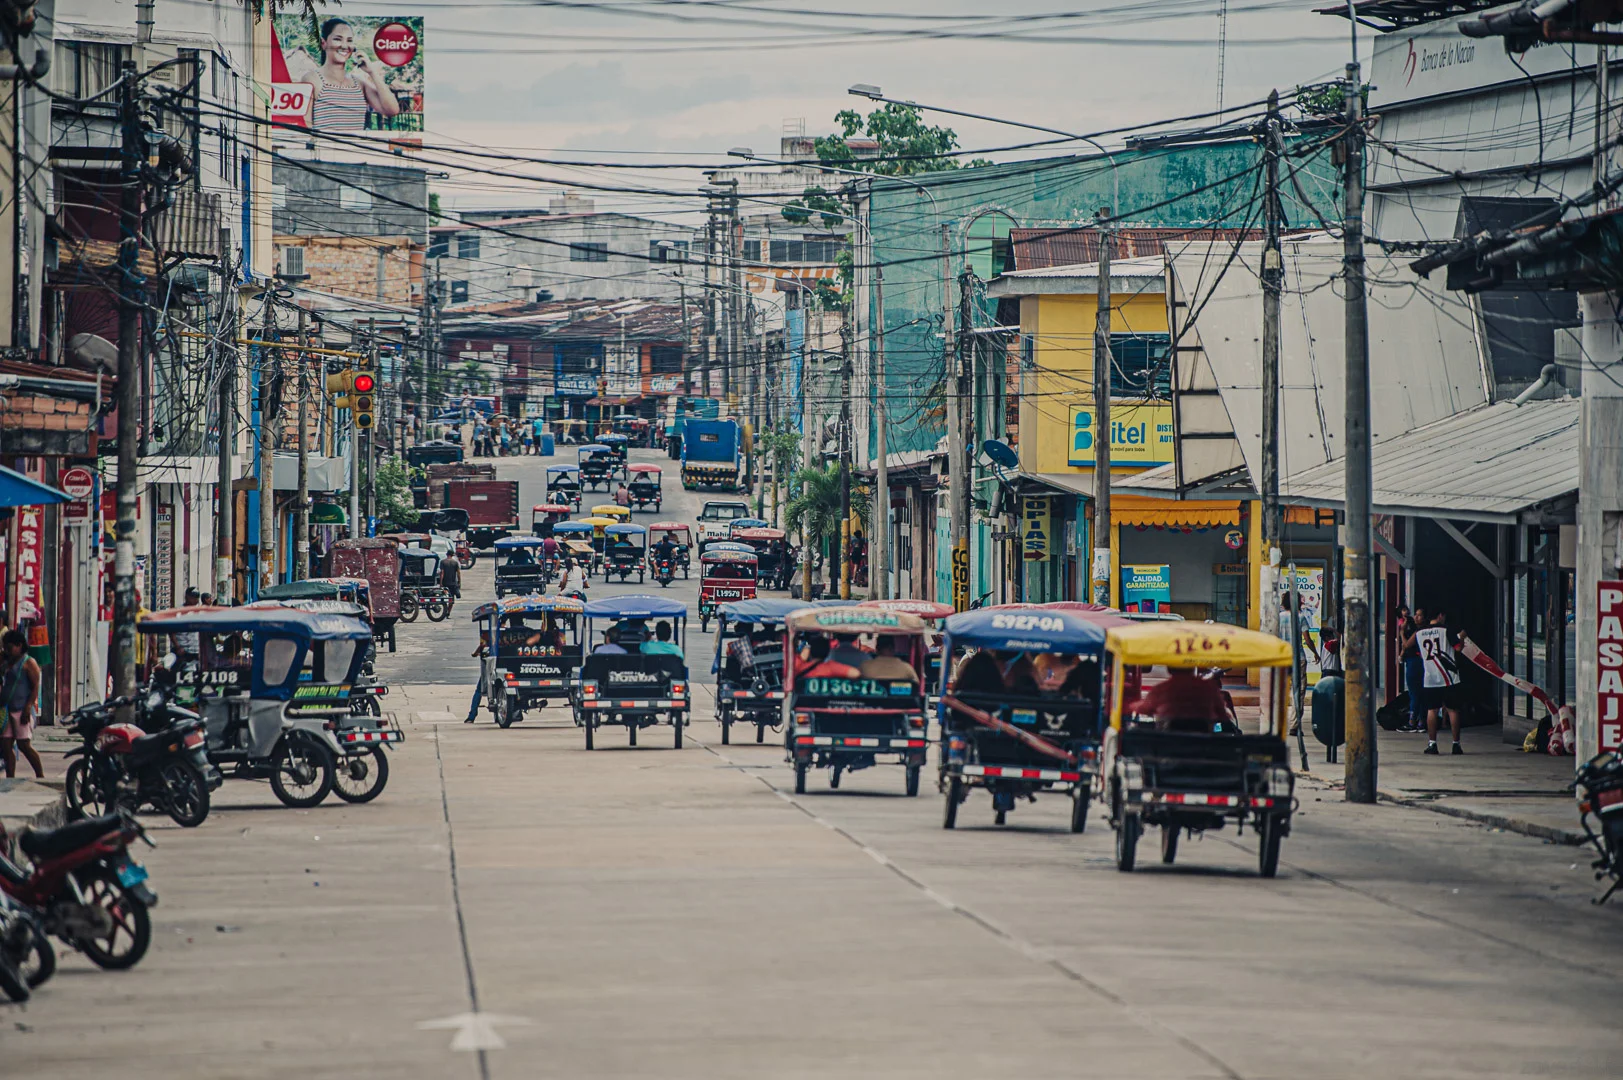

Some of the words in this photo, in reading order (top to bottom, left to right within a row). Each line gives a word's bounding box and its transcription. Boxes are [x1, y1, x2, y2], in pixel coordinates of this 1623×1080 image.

[375, 36, 412, 50] Claro
[1421, 49, 1439, 72] Banco
[1439, 47, 1446, 68] de
[1449, 45, 1456, 66] la
[1455, 39, 1475, 65] Nación
[1111, 421, 1146, 444] itel
[1025, 496, 1047, 550] OPIAS
[20, 505, 38, 598] ASAJE
[1132, 575, 1162, 583] CALIDAD
[1422, 637, 1441, 661] 21
[608, 673, 658, 682] HONDA
